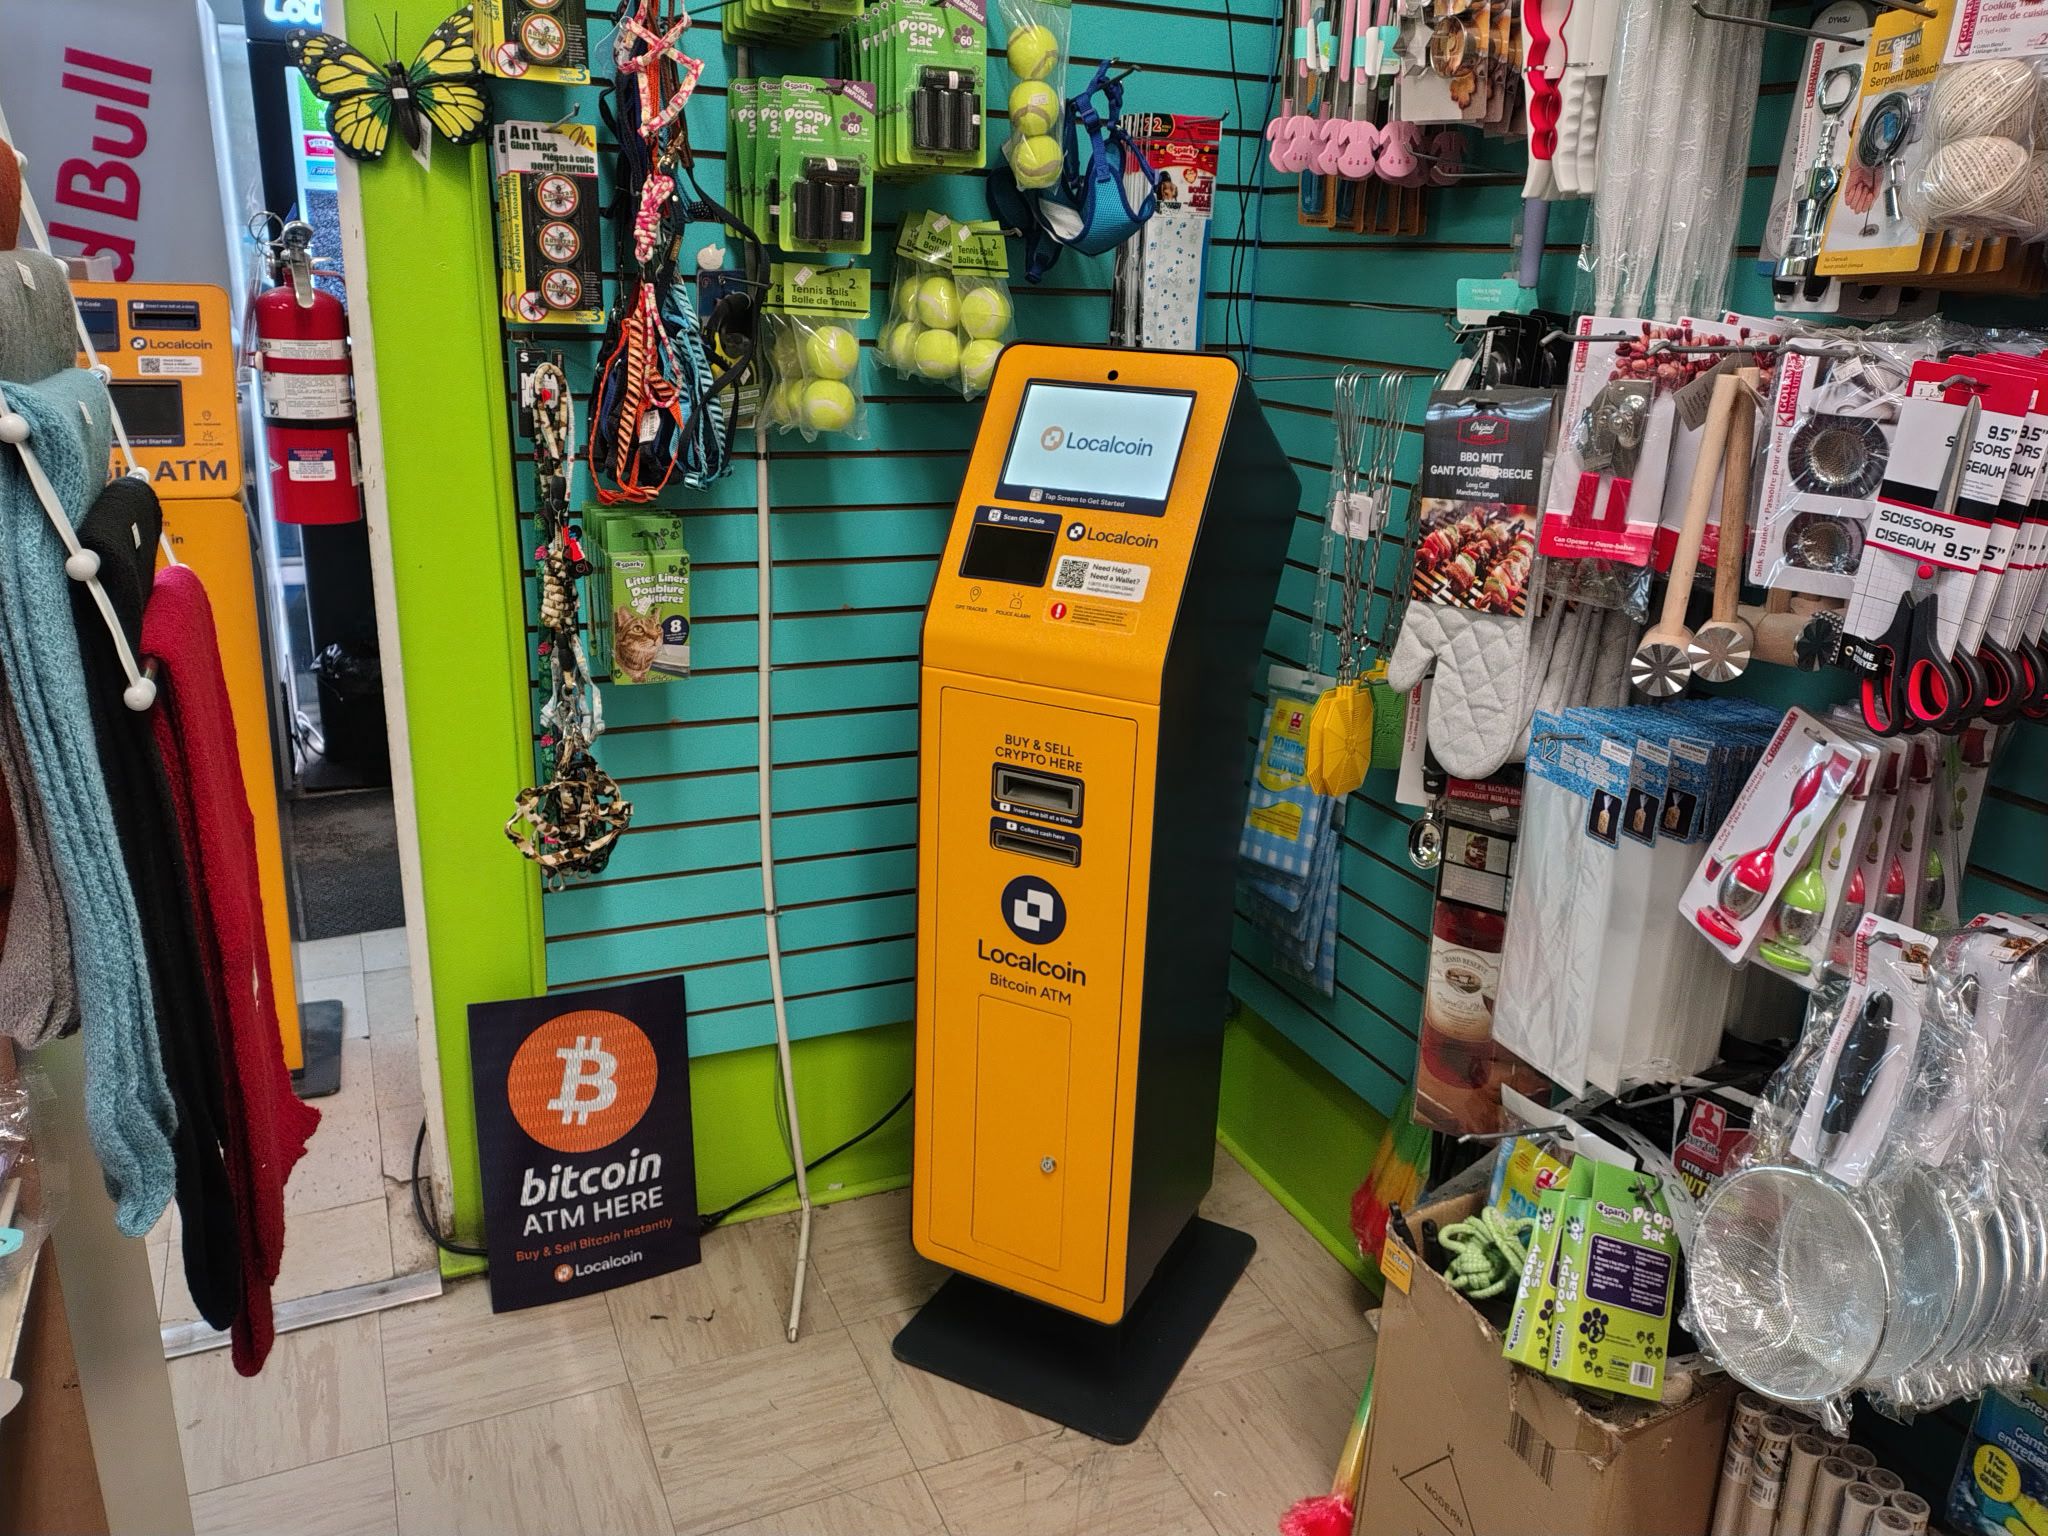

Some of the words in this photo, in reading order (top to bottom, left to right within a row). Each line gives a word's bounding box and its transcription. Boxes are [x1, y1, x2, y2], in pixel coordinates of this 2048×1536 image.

[1980, 11, 2008, 23] Ficelle
[2009, 11, 2020, 20] de
[898, 19, 945, 38] Poopy
[909, 32, 932, 47] Sac
[960, 35, 972, 46] 60
[1879, 40, 1892, 53] EZ
[1873, 59, 1894, 73] Drai
[1901, 53, 1920, 66] nake
[575, 63, 587, 81] 3
[1870, 71, 1903, 87] Serpent
[783, 107, 832, 127] Poopy
[1152, 117, 1162, 132] 2
[56, 47, 153, 221] Bull
[510, 125, 539, 141] Ant
[794, 121, 819, 135] Sac
[847, 123, 860, 134] 60
[510, 140, 531, 150] Glue
[532, 141, 558, 153] TRAPS
[958, 244, 978, 256] Tennis
[992, 238, 998, 250] 2
[791, 284, 824, 295] Tennis
[826, 286, 849, 297] Balls
[849, 278, 857, 290] 2
[791, 294, 815, 304] Balle
[816, 296, 828, 305] de
[830, 297, 857, 307] Tennis
[591, 307, 601, 322] 3
[150, 339, 213, 350] Localcoin
[520, 352, 529, 362] S
[1066, 431, 1154, 457] Localcoin
[1460, 452, 1479, 462] BBQ
[1481, 453, 1504, 463] MITT
[155, 460, 227, 482] ATM
[1430, 465, 1456, 475] GANT
[1457, 466, 1480, 477] POUR
[1044, 492, 1056, 501] Tap
[1056, 494, 1078, 504] Screen
[1087, 497, 1100, 506] Get
[1100, 499, 1125, 508] Started
[1003, 513, 1018, 521] Scan
[1754, 558, 1765, 578] Sink
[1764, 478, 1776, 514] Passoire
[1771, 456, 1781, 477] pour
[1879, 510, 1956, 539] SCISSORS
[1087, 527, 1159, 549] Localcoin
[1875, 528, 1937, 554] CISEAUX
[621, 560, 645, 569] sparky
[1092, 563, 1111, 573] Need
[1111, 565, 1132, 575] Help?
[625, 576, 656, 589] Litter
[658, 573, 689, 584] Liners
[1090, 573, 1109, 581] Need
[1115, 575, 1141, 585] Wallet?
[630, 584, 685, 597] Doublure
[966, 605, 988, 613] TRACKER
[995, 609, 1013, 617] POLICE
[670, 619, 682, 633] 8
[1004, 734, 1030, 748] BUY
[1033, 740, 1041, 751] &
[1044, 742, 1074, 757] SELL
[1541, 737, 1558, 766] 12
[995, 746, 1046, 765] CRYPTO
[1049, 756, 1083, 773] HERE
[1013, 807, 1029, 816] Insert
[1040, 811, 1049, 819] bill
[1059, 815, 1073, 824] time
[1019, 825, 1039, 835] Collect
[1039, 829, 1052, 837] cash
[1052, 831, 1066, 841] here
[978, 938, 1087, 987] Localcoin
[990, 972, 1037, 998] Bitcoin
[1040, 988, 1072, 1006] ATM
[520, 1147, 662, 1207] bitcoin
[523, 1204, 585, 1237] ATM
[592, 1186, 665, 1222] HERE
[1603, 1207, 1631, 1223] sparky
[516, 1247, 540, 1262] Buy
[543, 1245, 552, 1257] &
[553, 1241, 578, 1257] Sell
[579, 1231, 622, 1250] Bitcoin
[622, 1217, 674, 1241] Instantly
[1642, 1224, 1666, 1245] Sac
[575, 1249, 643, 1278] Localcoin
[1520, 1244, 1541, 1299] Poopy
[1531, 1260, 1545, 1288] Sac
[1555, 1254, 1573, 1313] Poopy
[1565, 1271, 1579, 1301] Sac
[1511, 1307, 1526, 1342] sparky
[1554, 1321, 1565, 1359] sparky
[1983, 1464, 2006, 1487] LARGE
